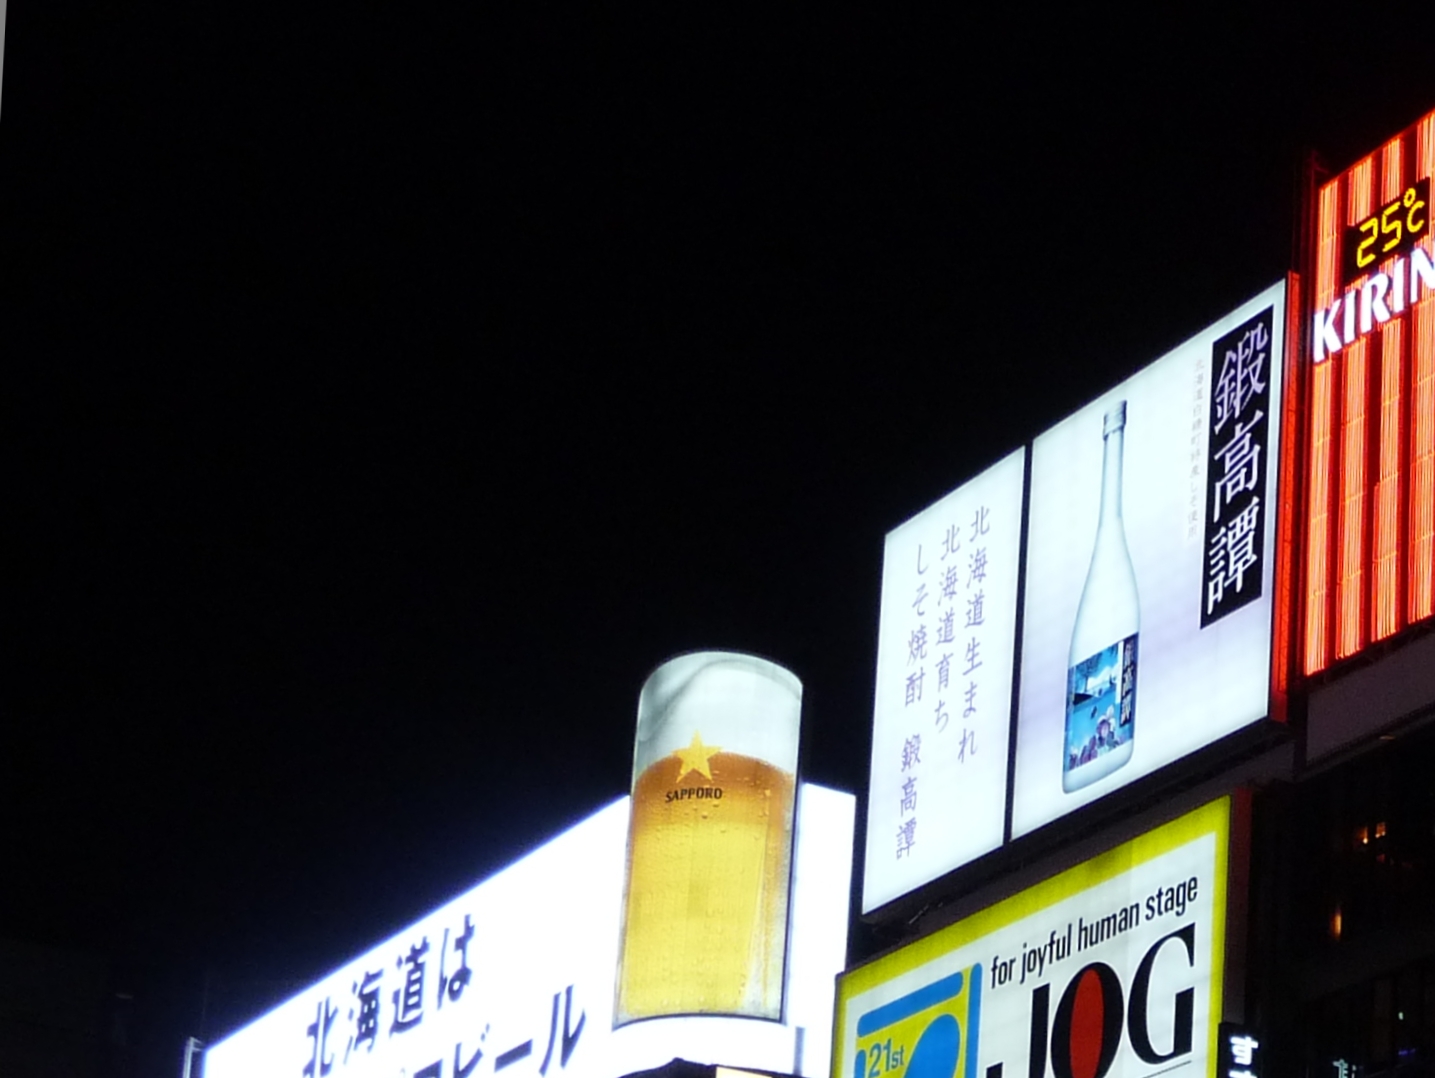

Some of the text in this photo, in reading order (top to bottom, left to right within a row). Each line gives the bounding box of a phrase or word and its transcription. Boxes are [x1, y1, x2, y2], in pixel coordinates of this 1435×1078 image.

[1207, 322, 1269, 616] 鍛高譚
[895, 543, 929, 861] しそ焼酎 鍛高譚
[933, 523, 961, 734] 北海道育ち
[957, 505, 990, 765] 北海道生まれ
[665, 787, 723, 803] SAPPORO
[990, 875, 1199, 990] for joyful human stage
